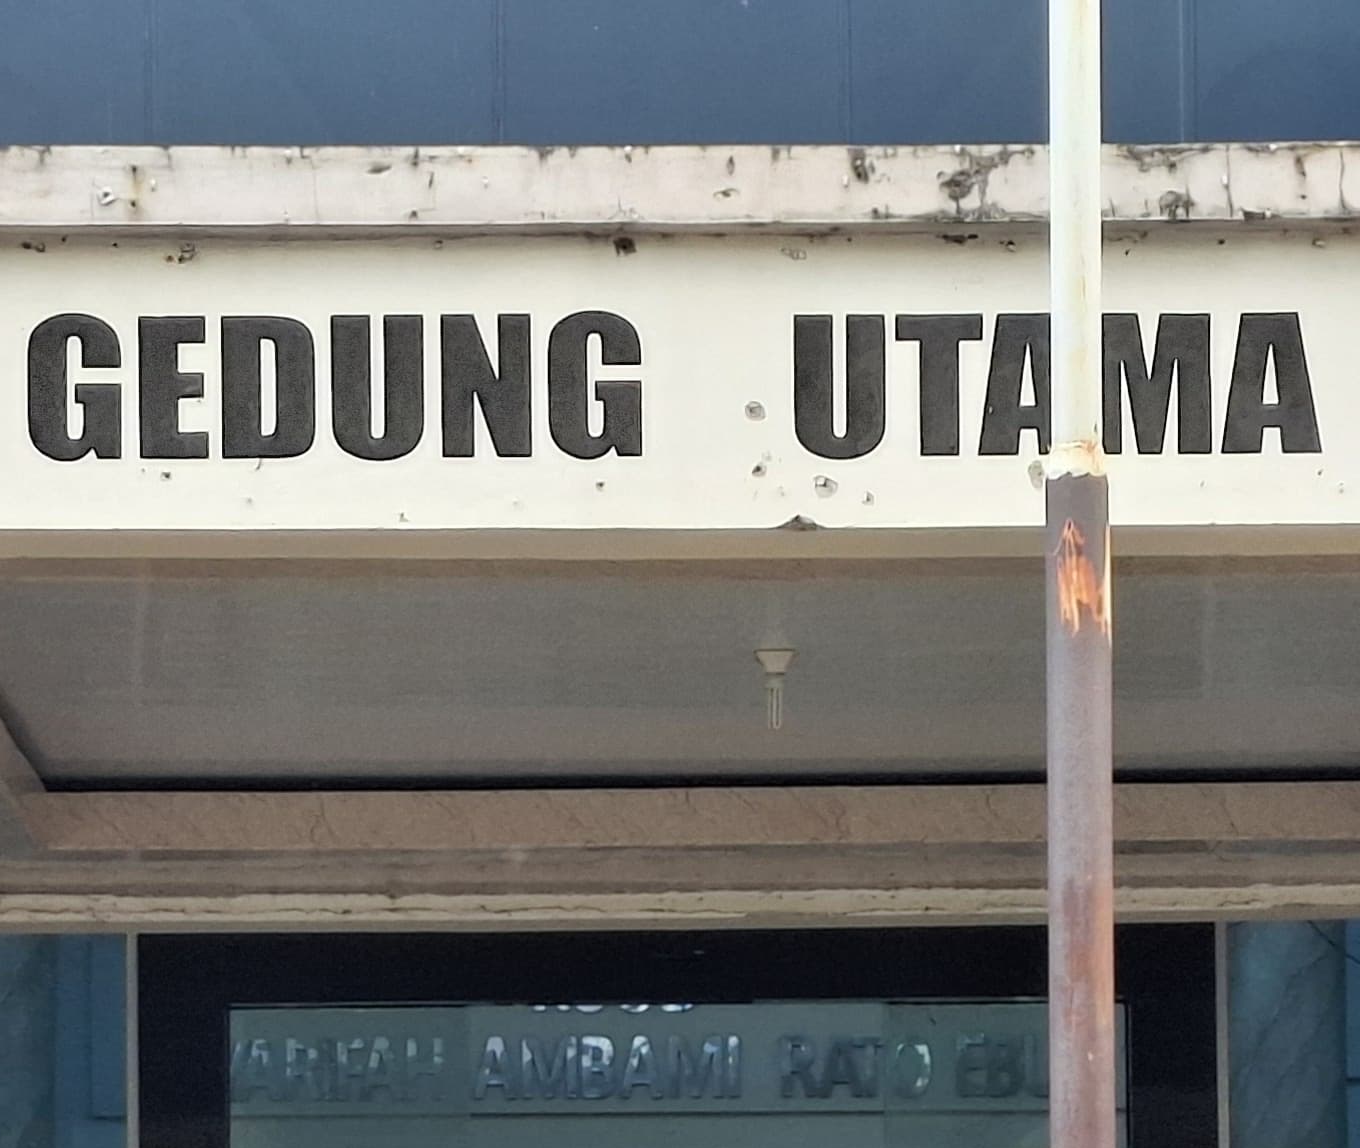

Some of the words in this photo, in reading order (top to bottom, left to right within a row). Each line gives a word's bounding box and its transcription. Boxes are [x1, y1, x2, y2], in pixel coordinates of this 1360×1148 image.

[26, 311, 641, 461] GEDUNG
[793, 312, 1323, 459] UTAMA
[474, 1034, 741, 1100] AMBAMI
[780, 1034, 931, 1099] RATO
